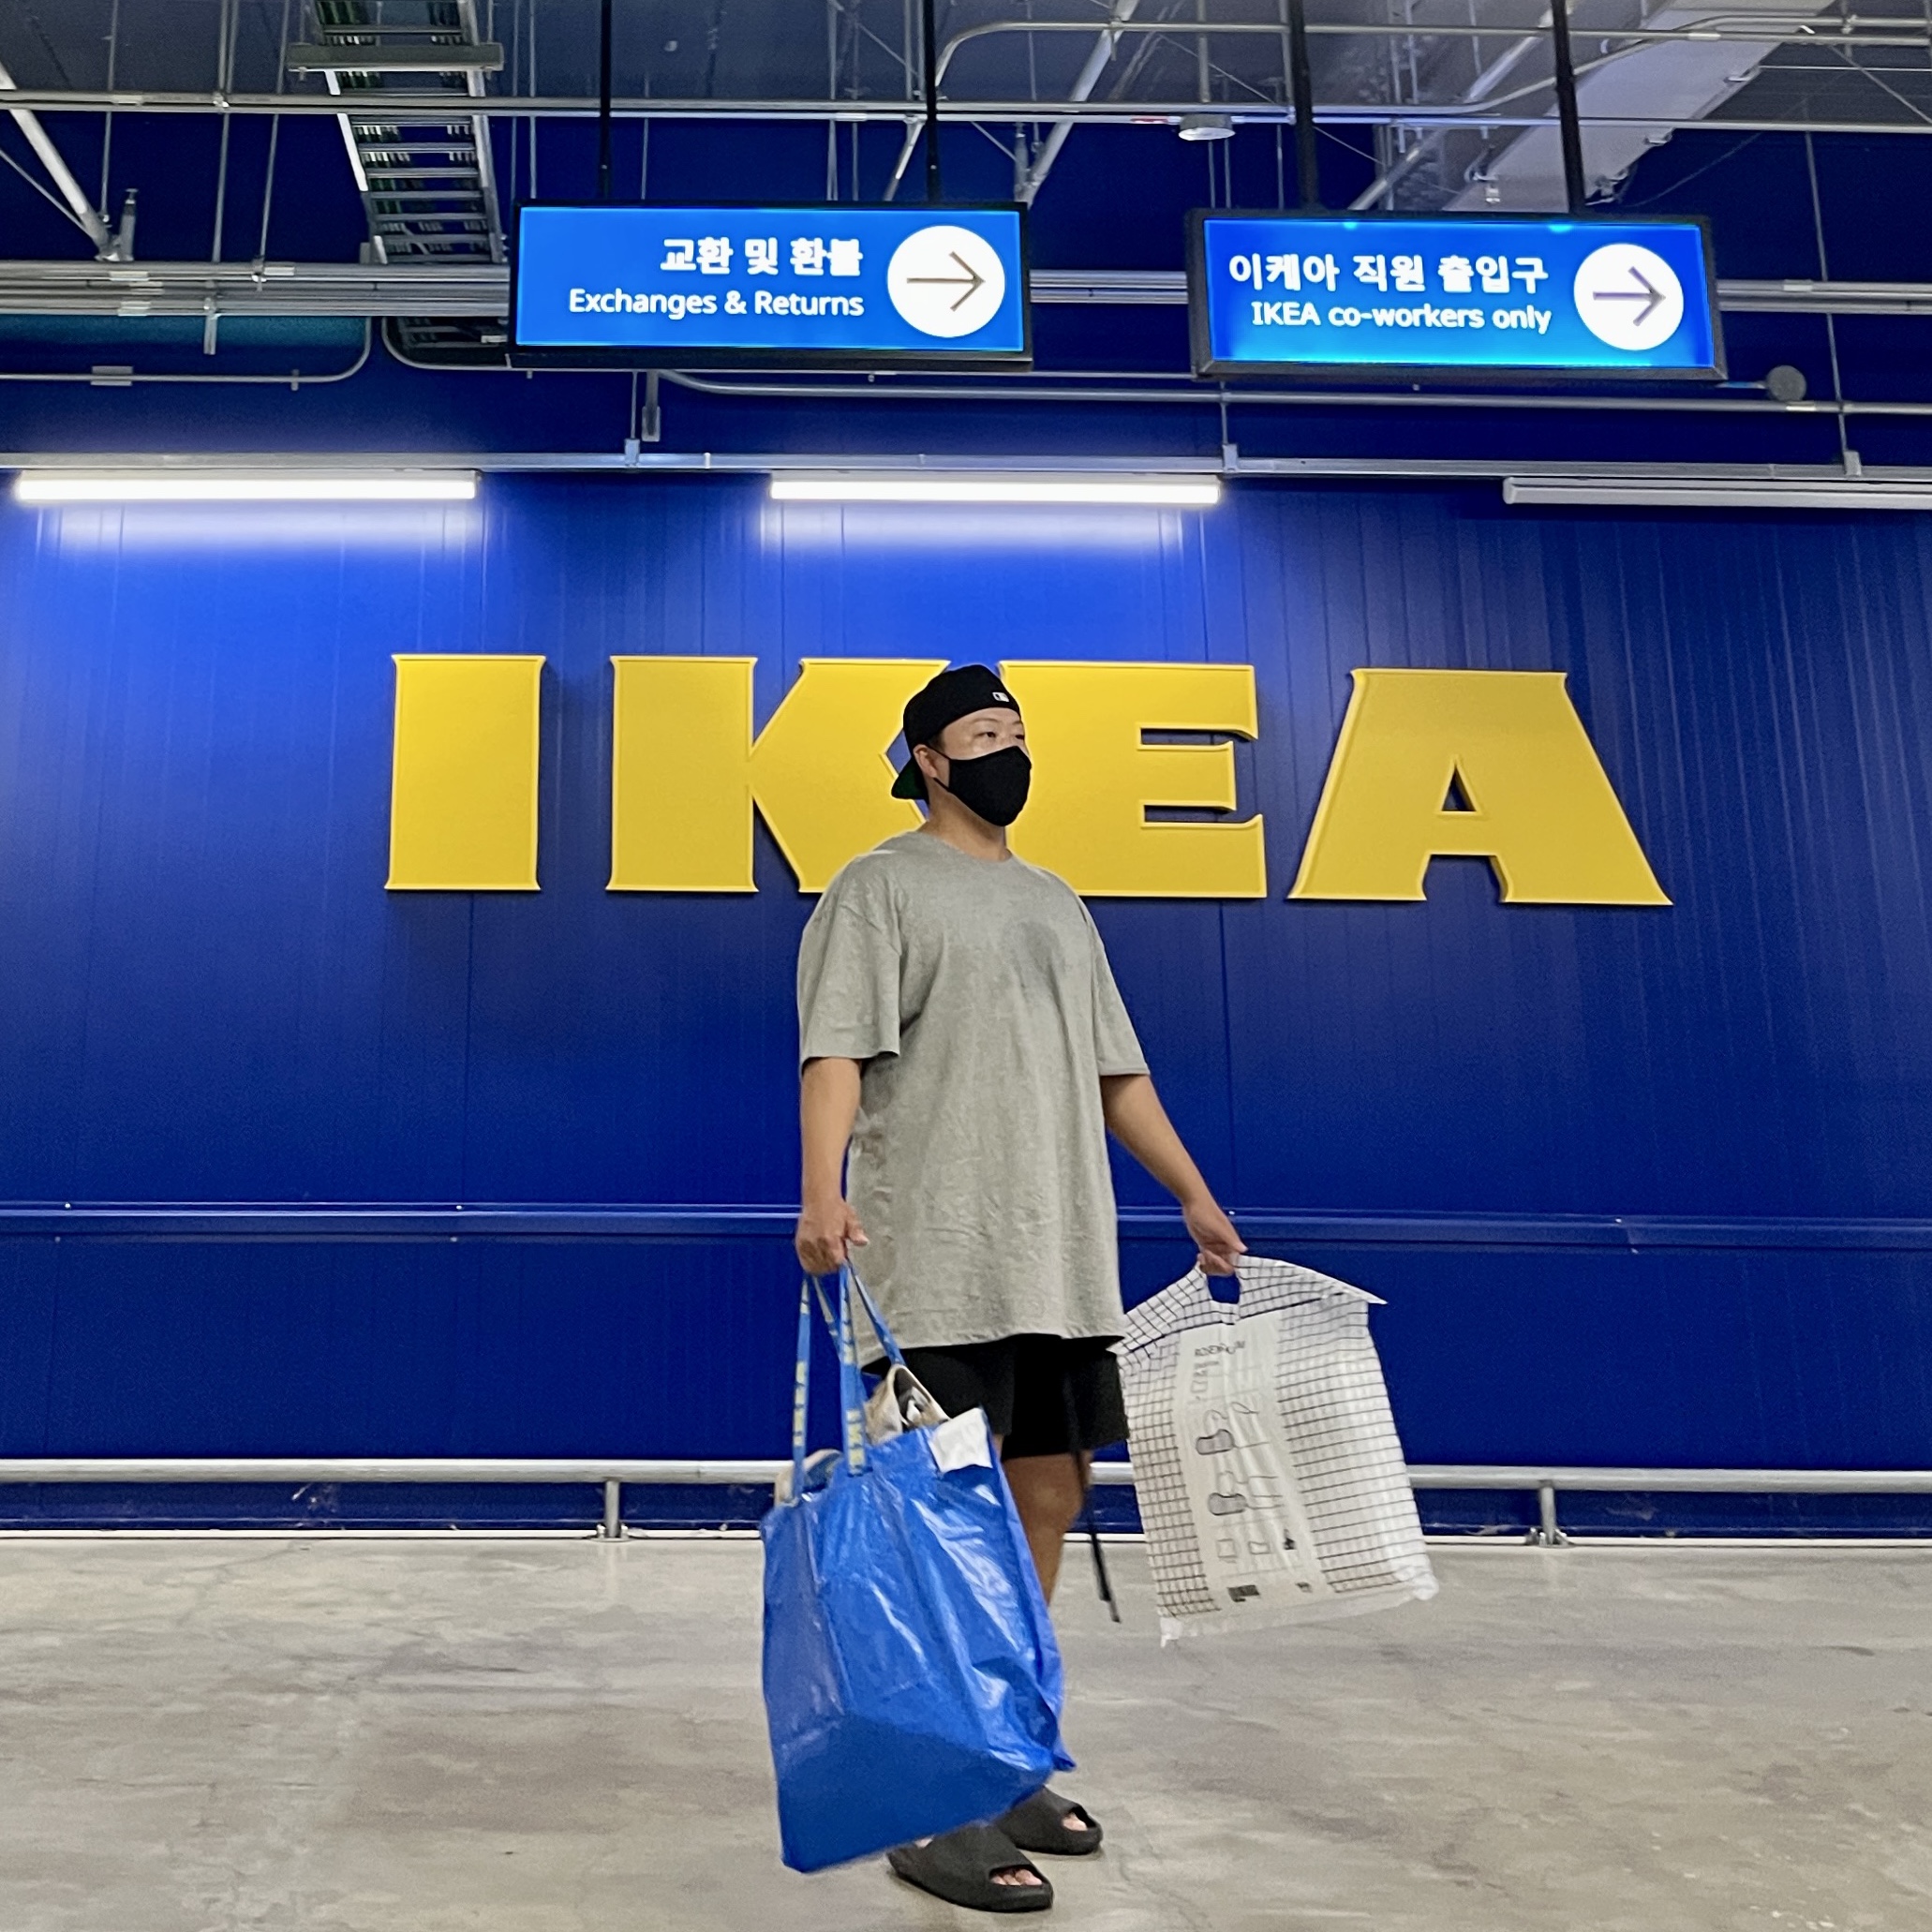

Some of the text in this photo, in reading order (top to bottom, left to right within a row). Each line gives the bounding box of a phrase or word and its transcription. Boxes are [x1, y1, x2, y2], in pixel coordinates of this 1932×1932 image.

[659, 236, 734, 275] 교환
[744, 237, 779, 275] 및
[1229, 253, 1549, 294] 이케아 직원 출입구
[569, 288, 865, 320] Exchanges & Returns
[1251, 301, 1552, 334] IKEA co-workers only
[386, 654, 1672, 906] IKEA
